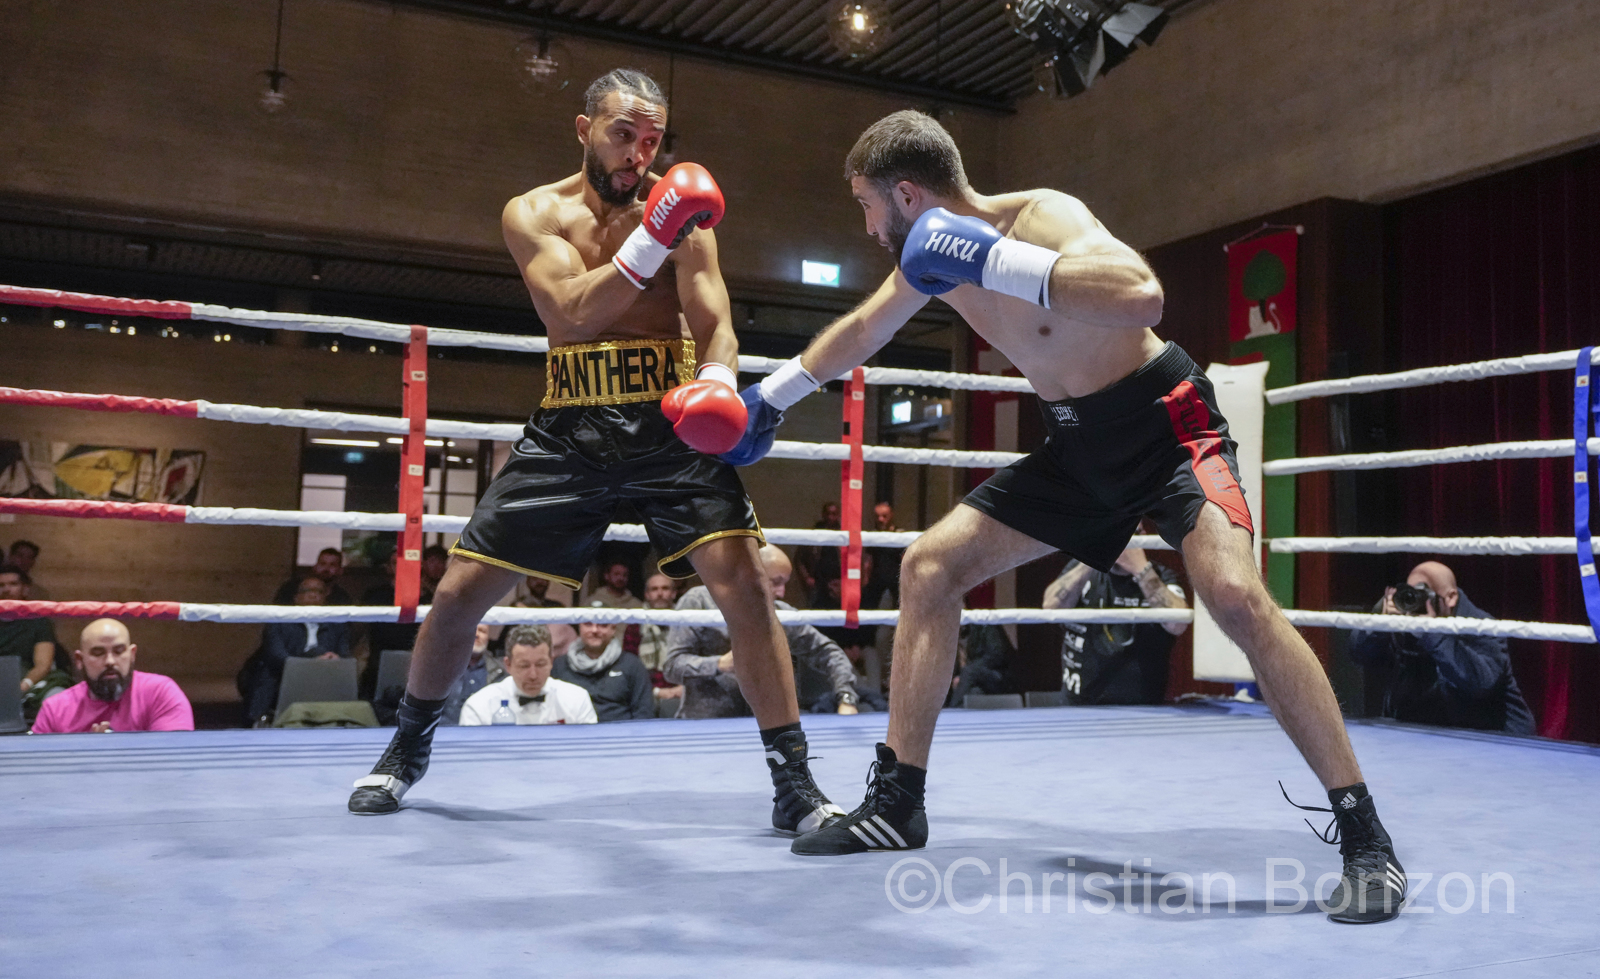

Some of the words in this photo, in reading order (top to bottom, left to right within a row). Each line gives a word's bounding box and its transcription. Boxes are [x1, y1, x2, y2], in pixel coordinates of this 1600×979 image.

[650, 187, 682, 230] HIKU
[925, 231, 980, 262] HIKU
[551, 346, 680, 399] PANTHERA
